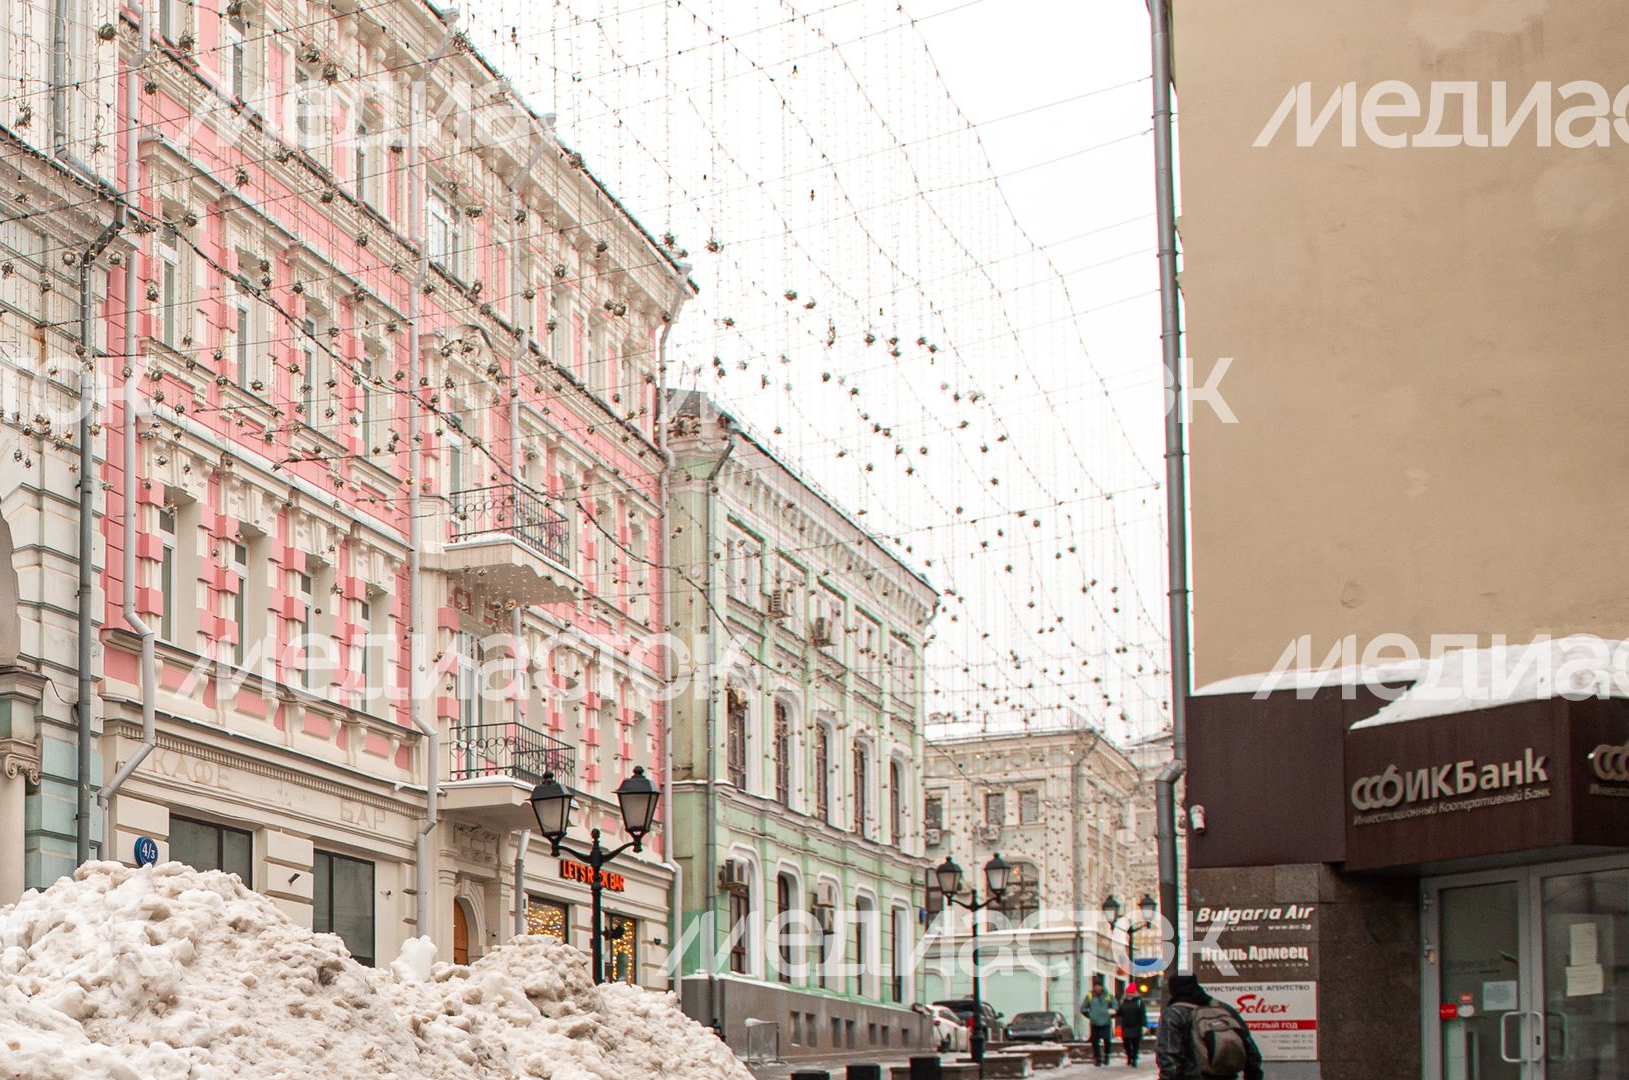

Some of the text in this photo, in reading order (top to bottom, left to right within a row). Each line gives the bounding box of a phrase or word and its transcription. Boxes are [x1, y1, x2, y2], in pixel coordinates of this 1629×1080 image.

[339, 798, 386, 830] БАР
[1353, 786, 1551, 826] Инвестиционный Кооперативный Банк
[141, 842, 156, 859] 4/3
[610, 871, 625, 892] BAR
[1196, 904, 1314, 925] Bulgaria Air
[1201, 945, 1309, 962] Итиль Армеец
[1203, 984, 1310, 993] УРИСТИЧЕСКОЕ АГЕНТСТВО
[1236, 993, 1290, 1014] Solvex
[1281, 1022, 1298, 1030] ГОД
